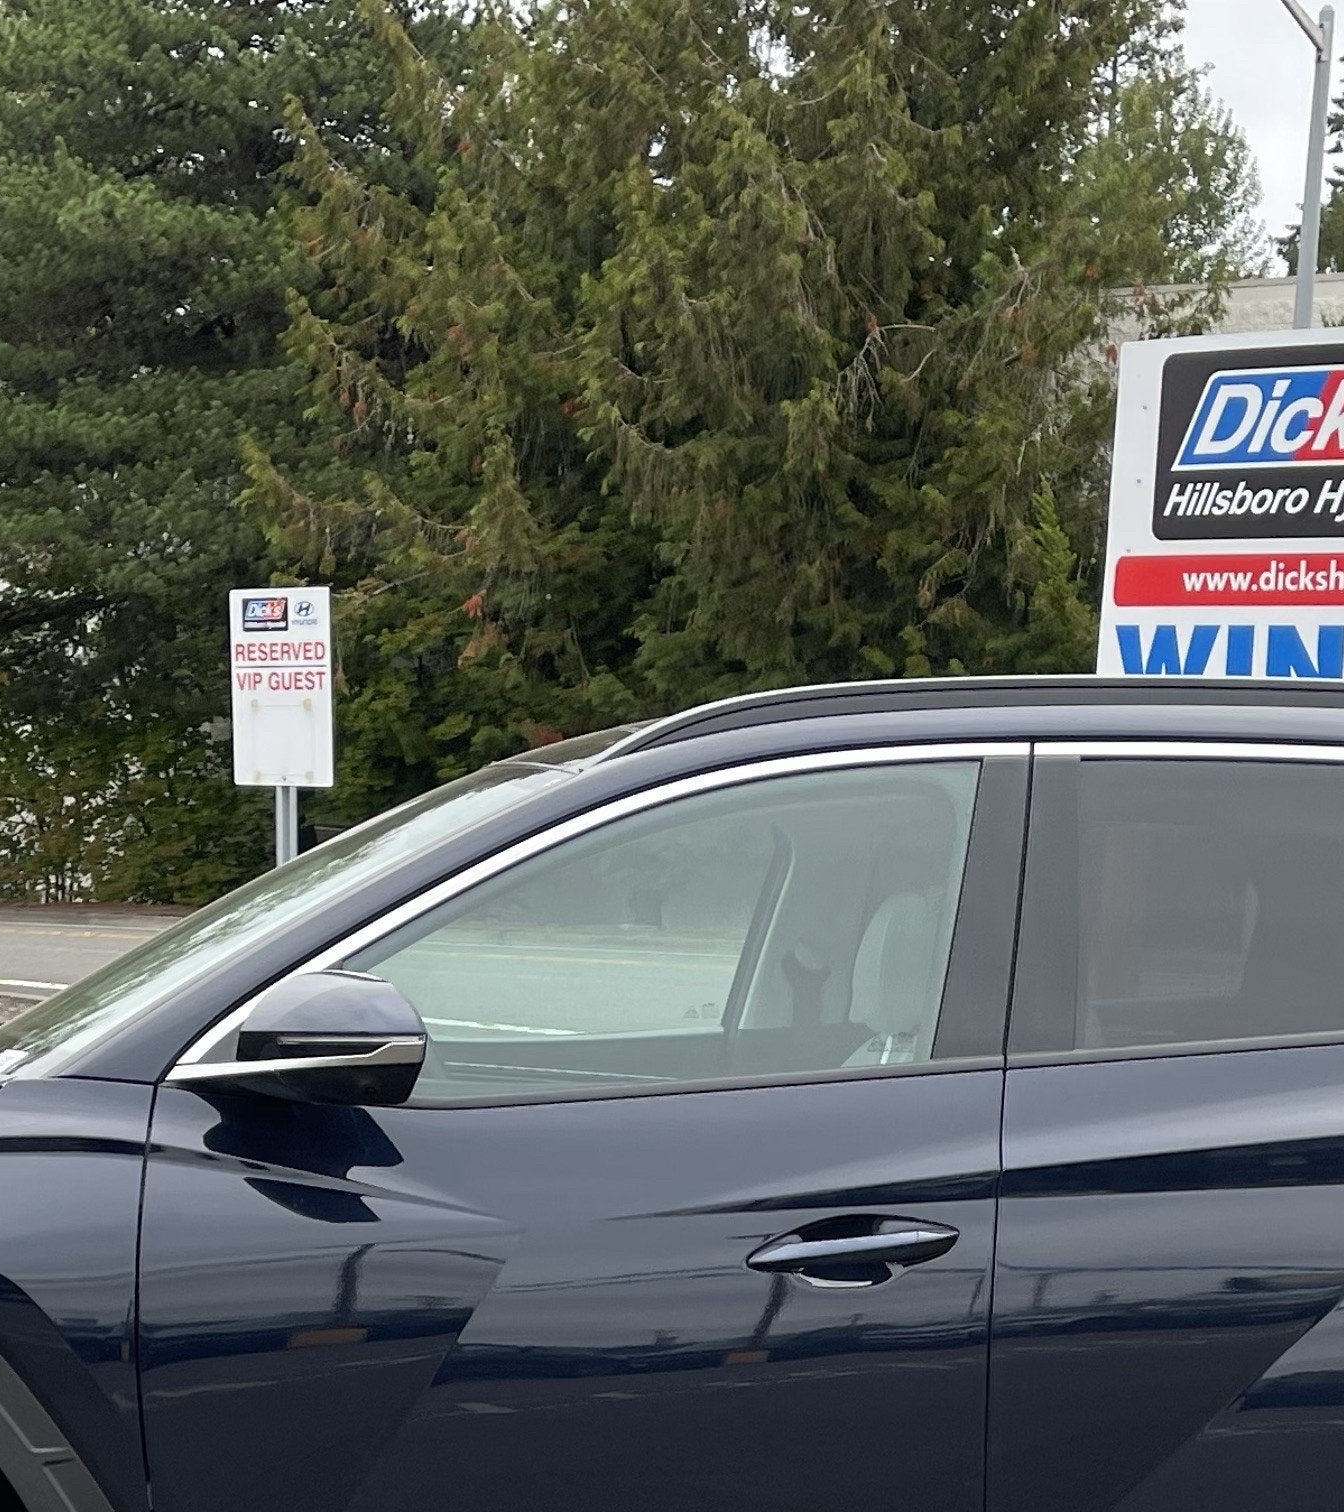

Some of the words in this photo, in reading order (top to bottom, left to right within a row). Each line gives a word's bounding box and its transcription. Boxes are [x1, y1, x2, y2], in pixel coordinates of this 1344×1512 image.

[1162, 481, 1310, 517] Hillsboro
[235, 641, 326, 662] RESERVED
[236, 671, 263, 691] VIP
[268, 670, 326, 691] GUEST
